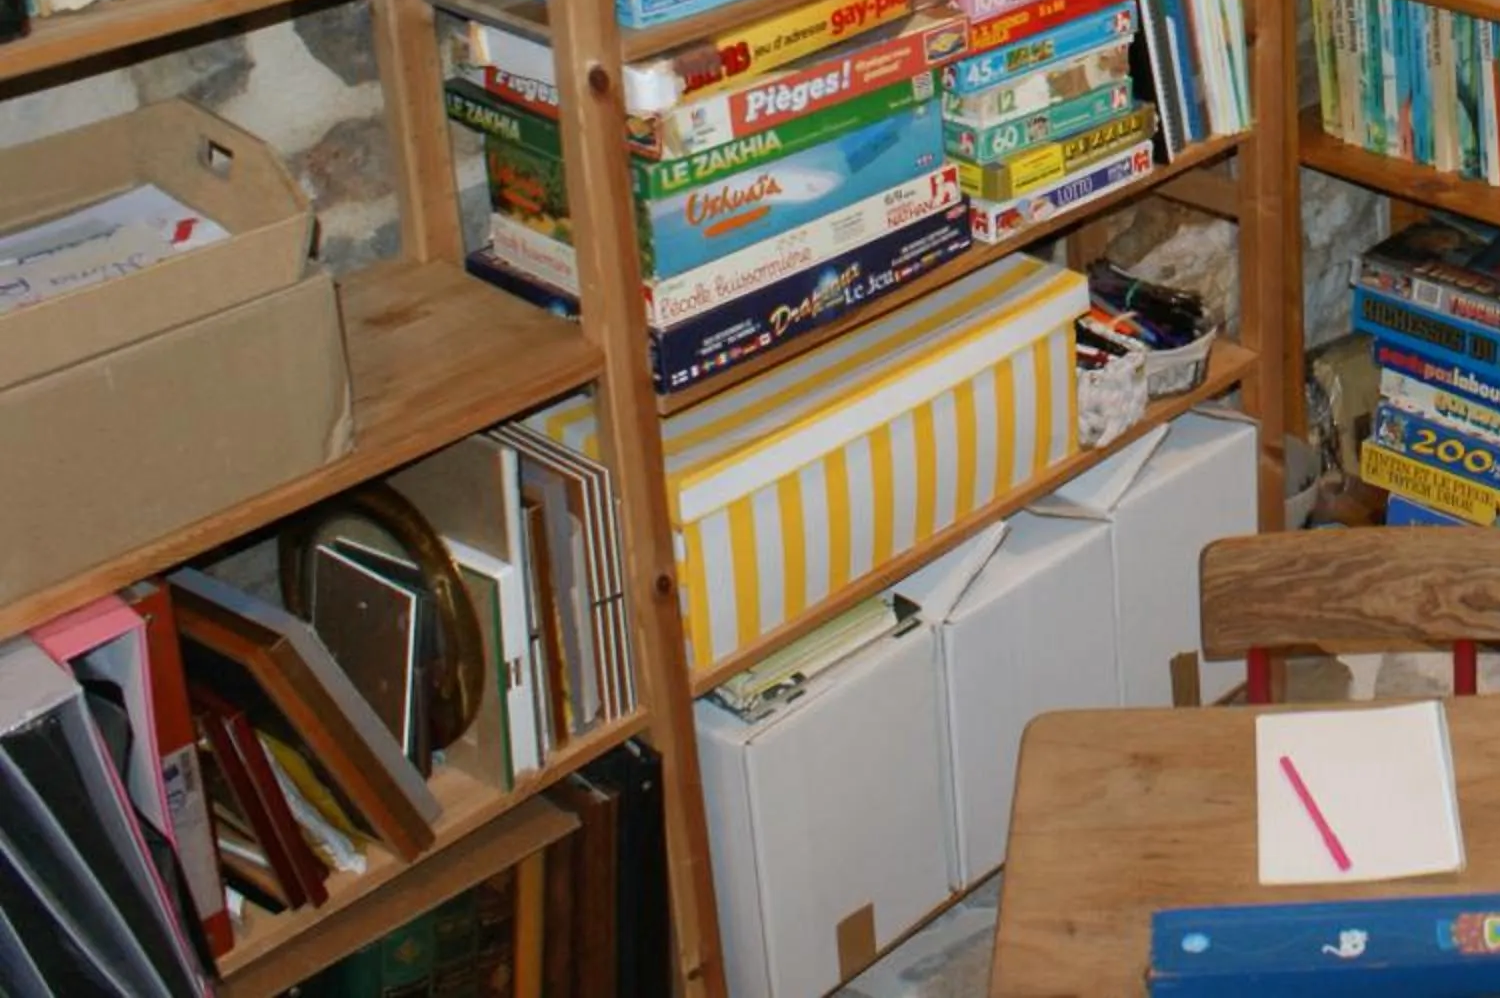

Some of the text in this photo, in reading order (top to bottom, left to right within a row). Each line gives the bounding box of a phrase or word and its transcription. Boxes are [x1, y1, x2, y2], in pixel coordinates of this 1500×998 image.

[744, 59, 852, 125] Pièges!
[661, 129, 783, 190] LE ZAKHIA
[1056, 177, 1093, 203] LOTTO
[1411, 428, 1494, 474] 200
